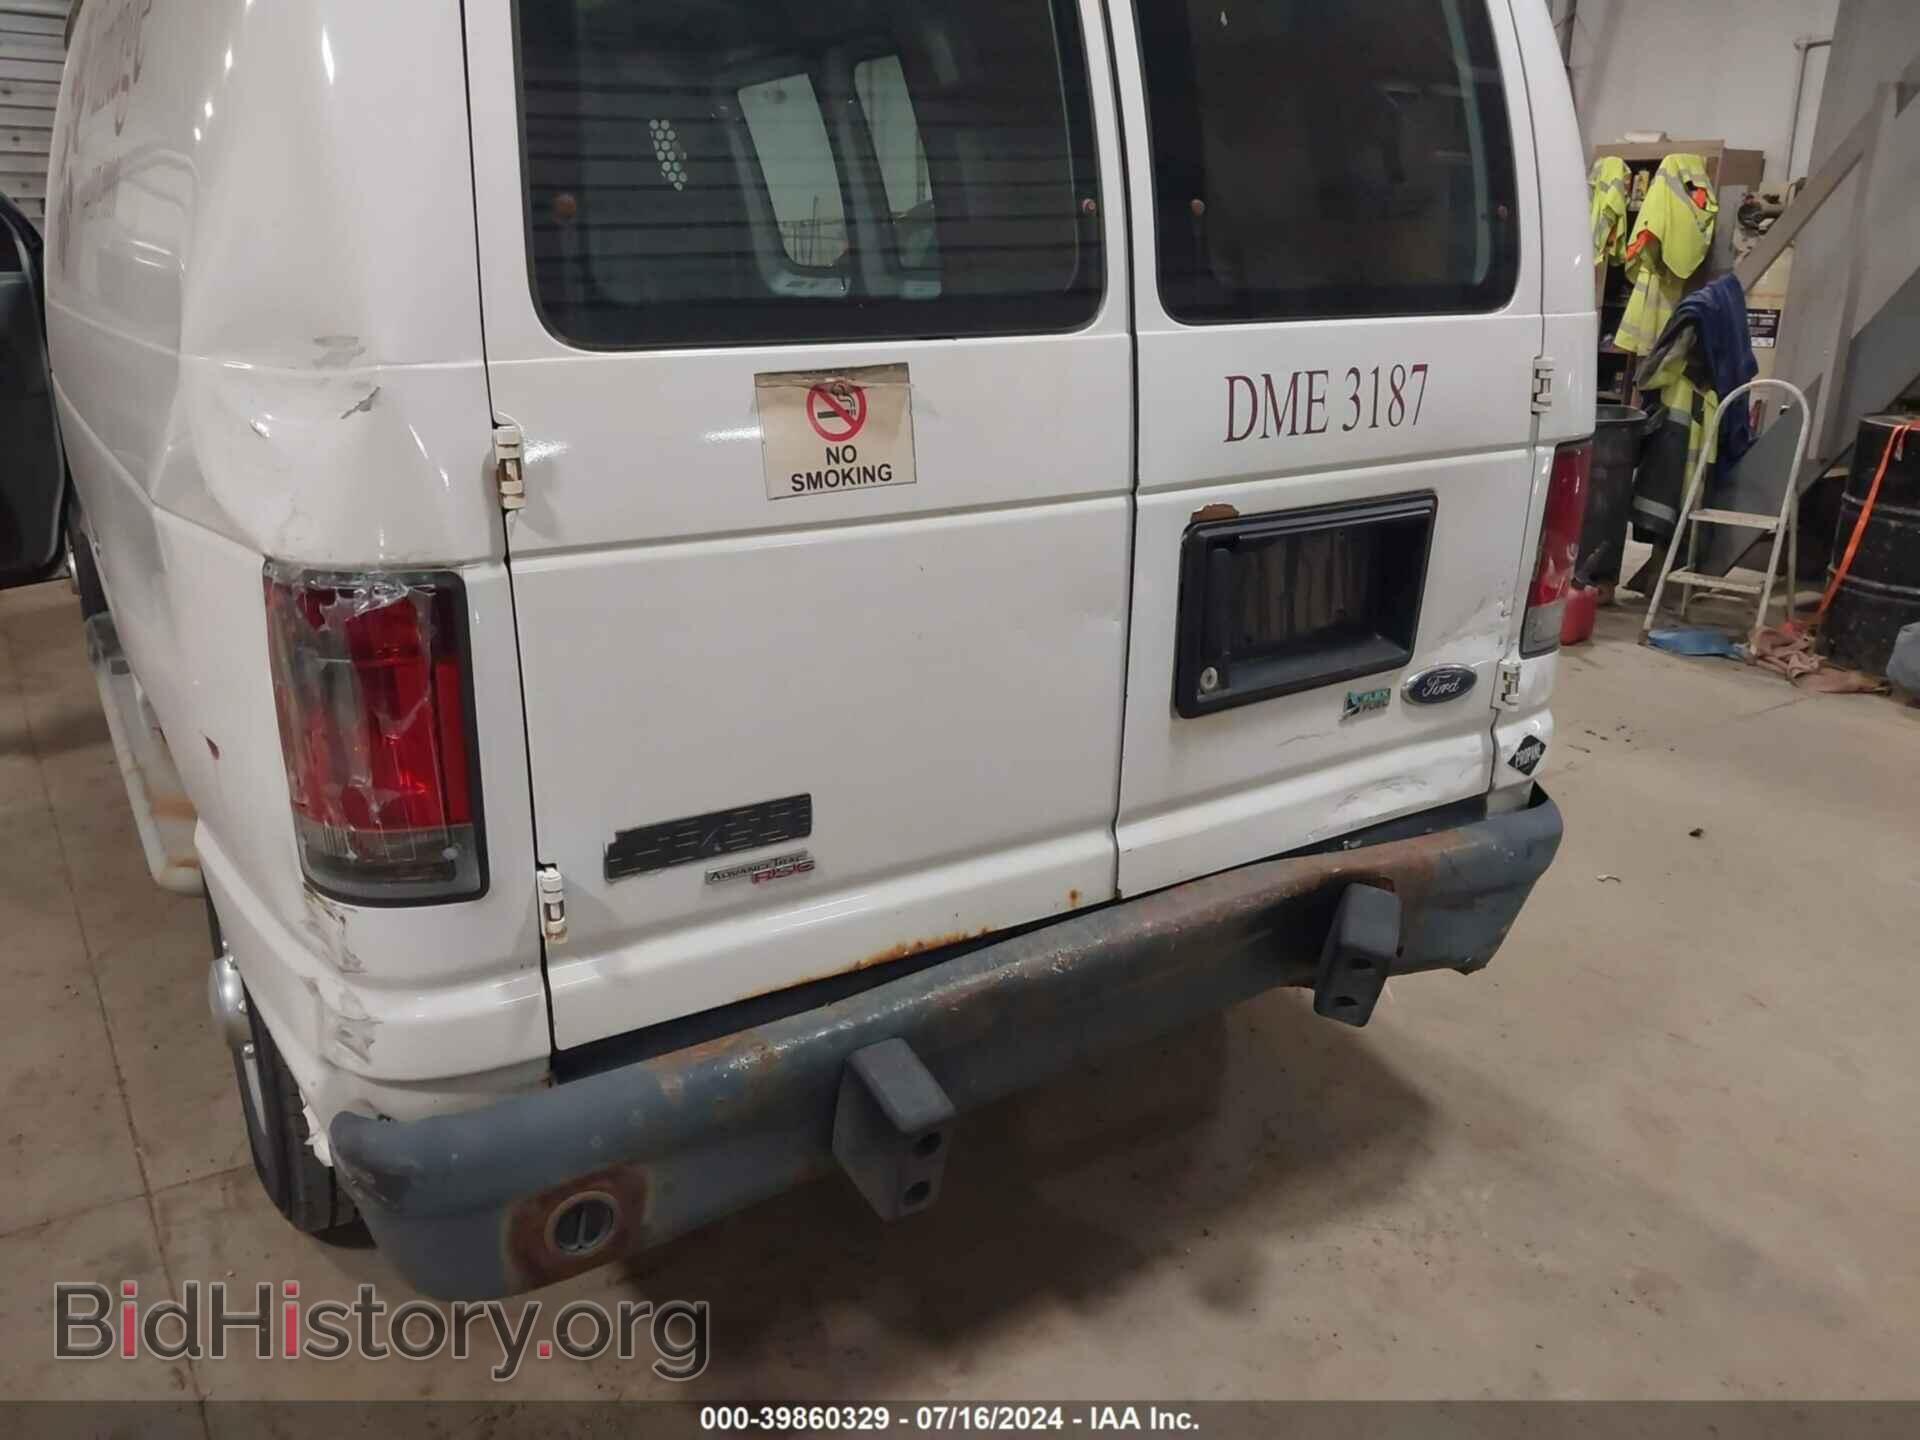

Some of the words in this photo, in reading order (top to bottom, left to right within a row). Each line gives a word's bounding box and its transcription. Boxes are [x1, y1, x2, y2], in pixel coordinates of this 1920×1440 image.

[1223, 369, 1330, 443] DME
[1342, 363, 1429, 432] 3187
[825, 444, 857, 466] NO
[791, 463, 893, 492] SMOKING
[1421, 671, 1460, 697] Ford
